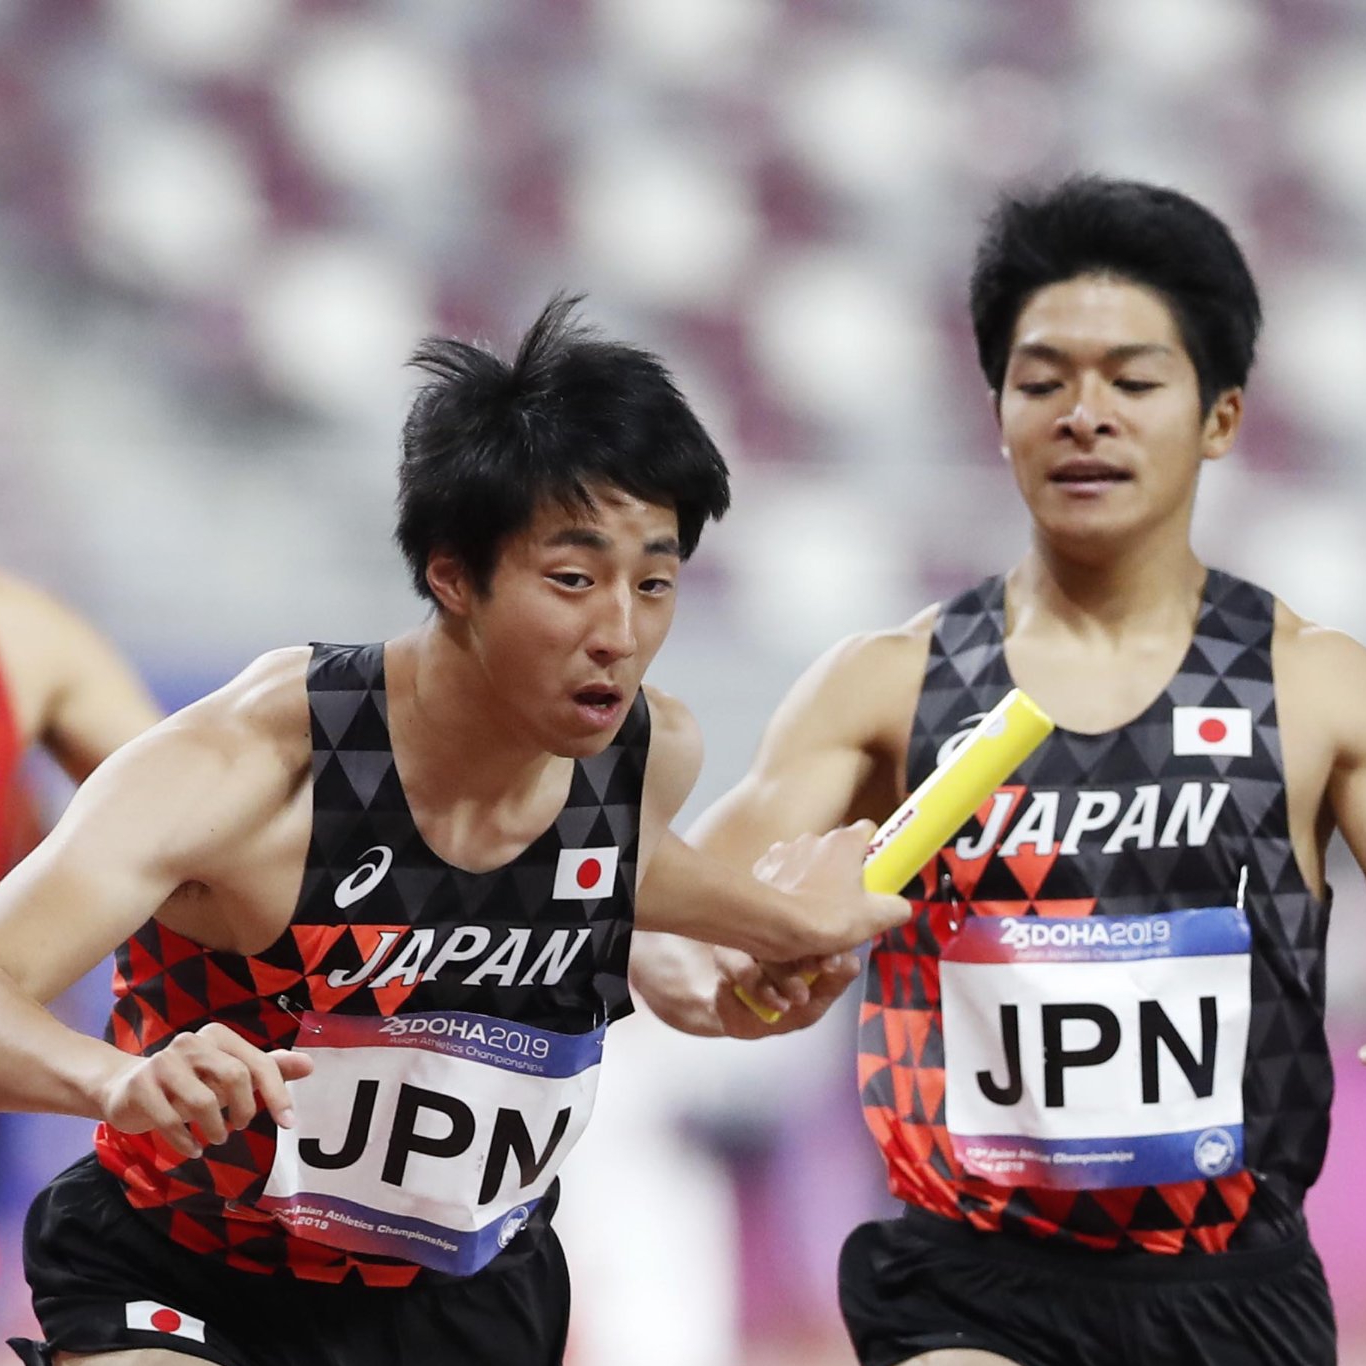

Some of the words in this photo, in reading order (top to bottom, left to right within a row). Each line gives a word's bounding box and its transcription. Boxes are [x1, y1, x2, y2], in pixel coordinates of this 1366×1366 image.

[954, 782, 1231, 860] JAPAN
[326, 926, 593, 988] JAPAN
[420, 1036, 464, 1055] Athletics
[465, 1045, 544, 1073] Championships
[976, 996, 1218, 1108] JPN
[297, 1080, 573, 1206] JPN
[296, 1215, 330, 1231] 2019
[325, 1209, 375, 1232] Athletics
[376, 1224, 459, 1252] Championships
